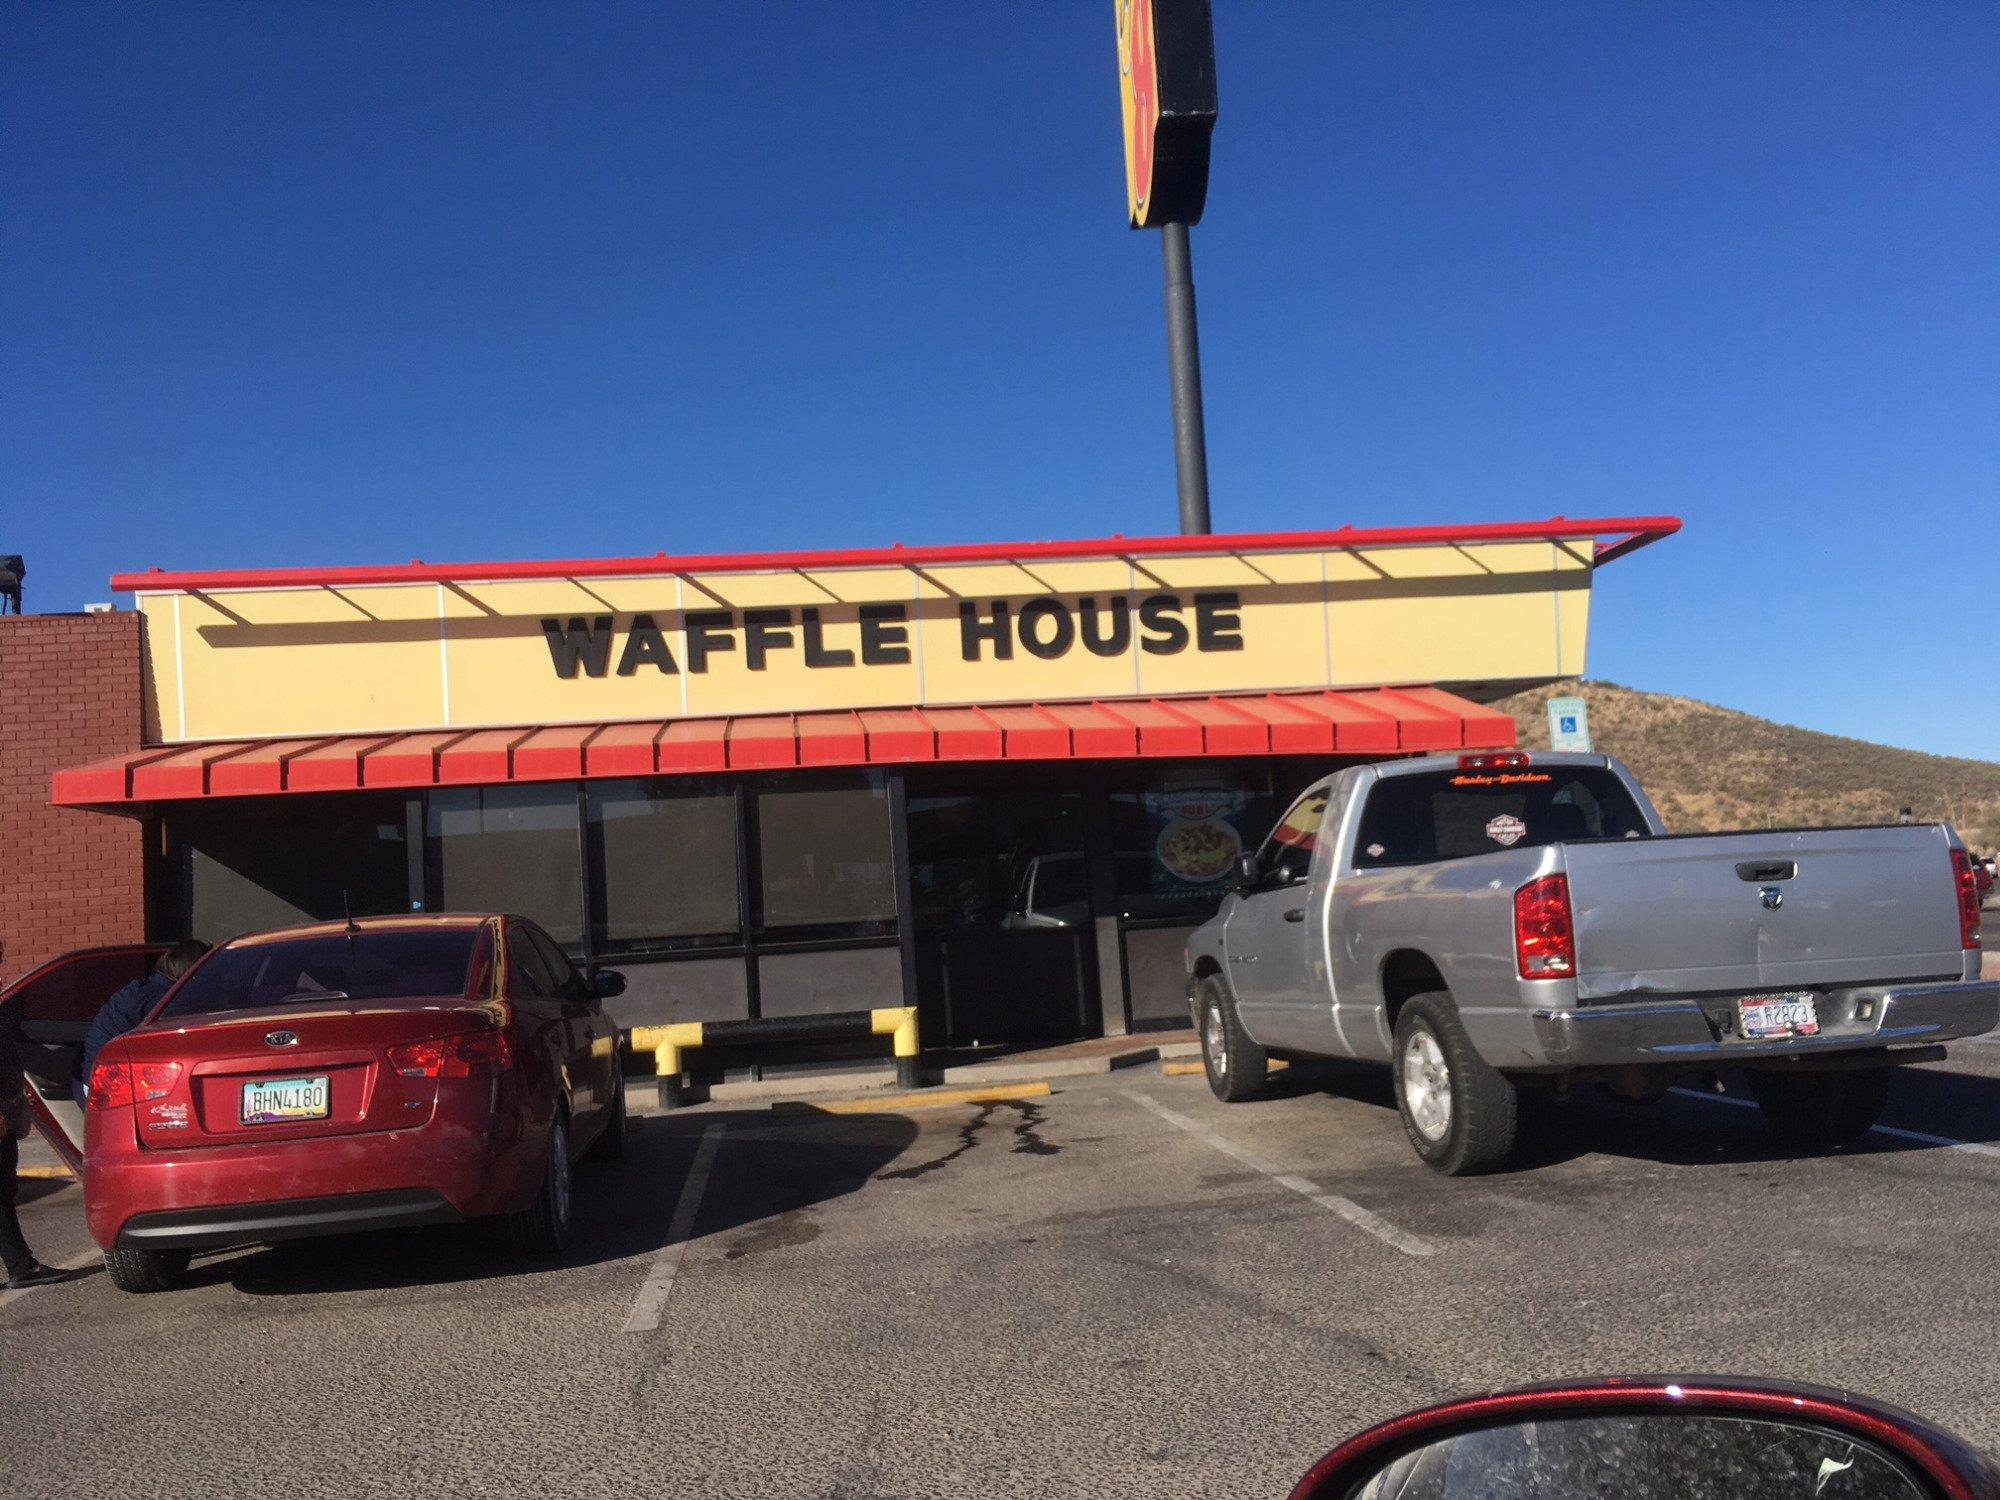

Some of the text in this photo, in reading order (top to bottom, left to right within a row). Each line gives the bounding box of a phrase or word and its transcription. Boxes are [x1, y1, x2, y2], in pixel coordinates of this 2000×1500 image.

[541, 592, 1244, 679] WAFFLE HOUSE
[253, 1086, 323, 1112] BHN4180
